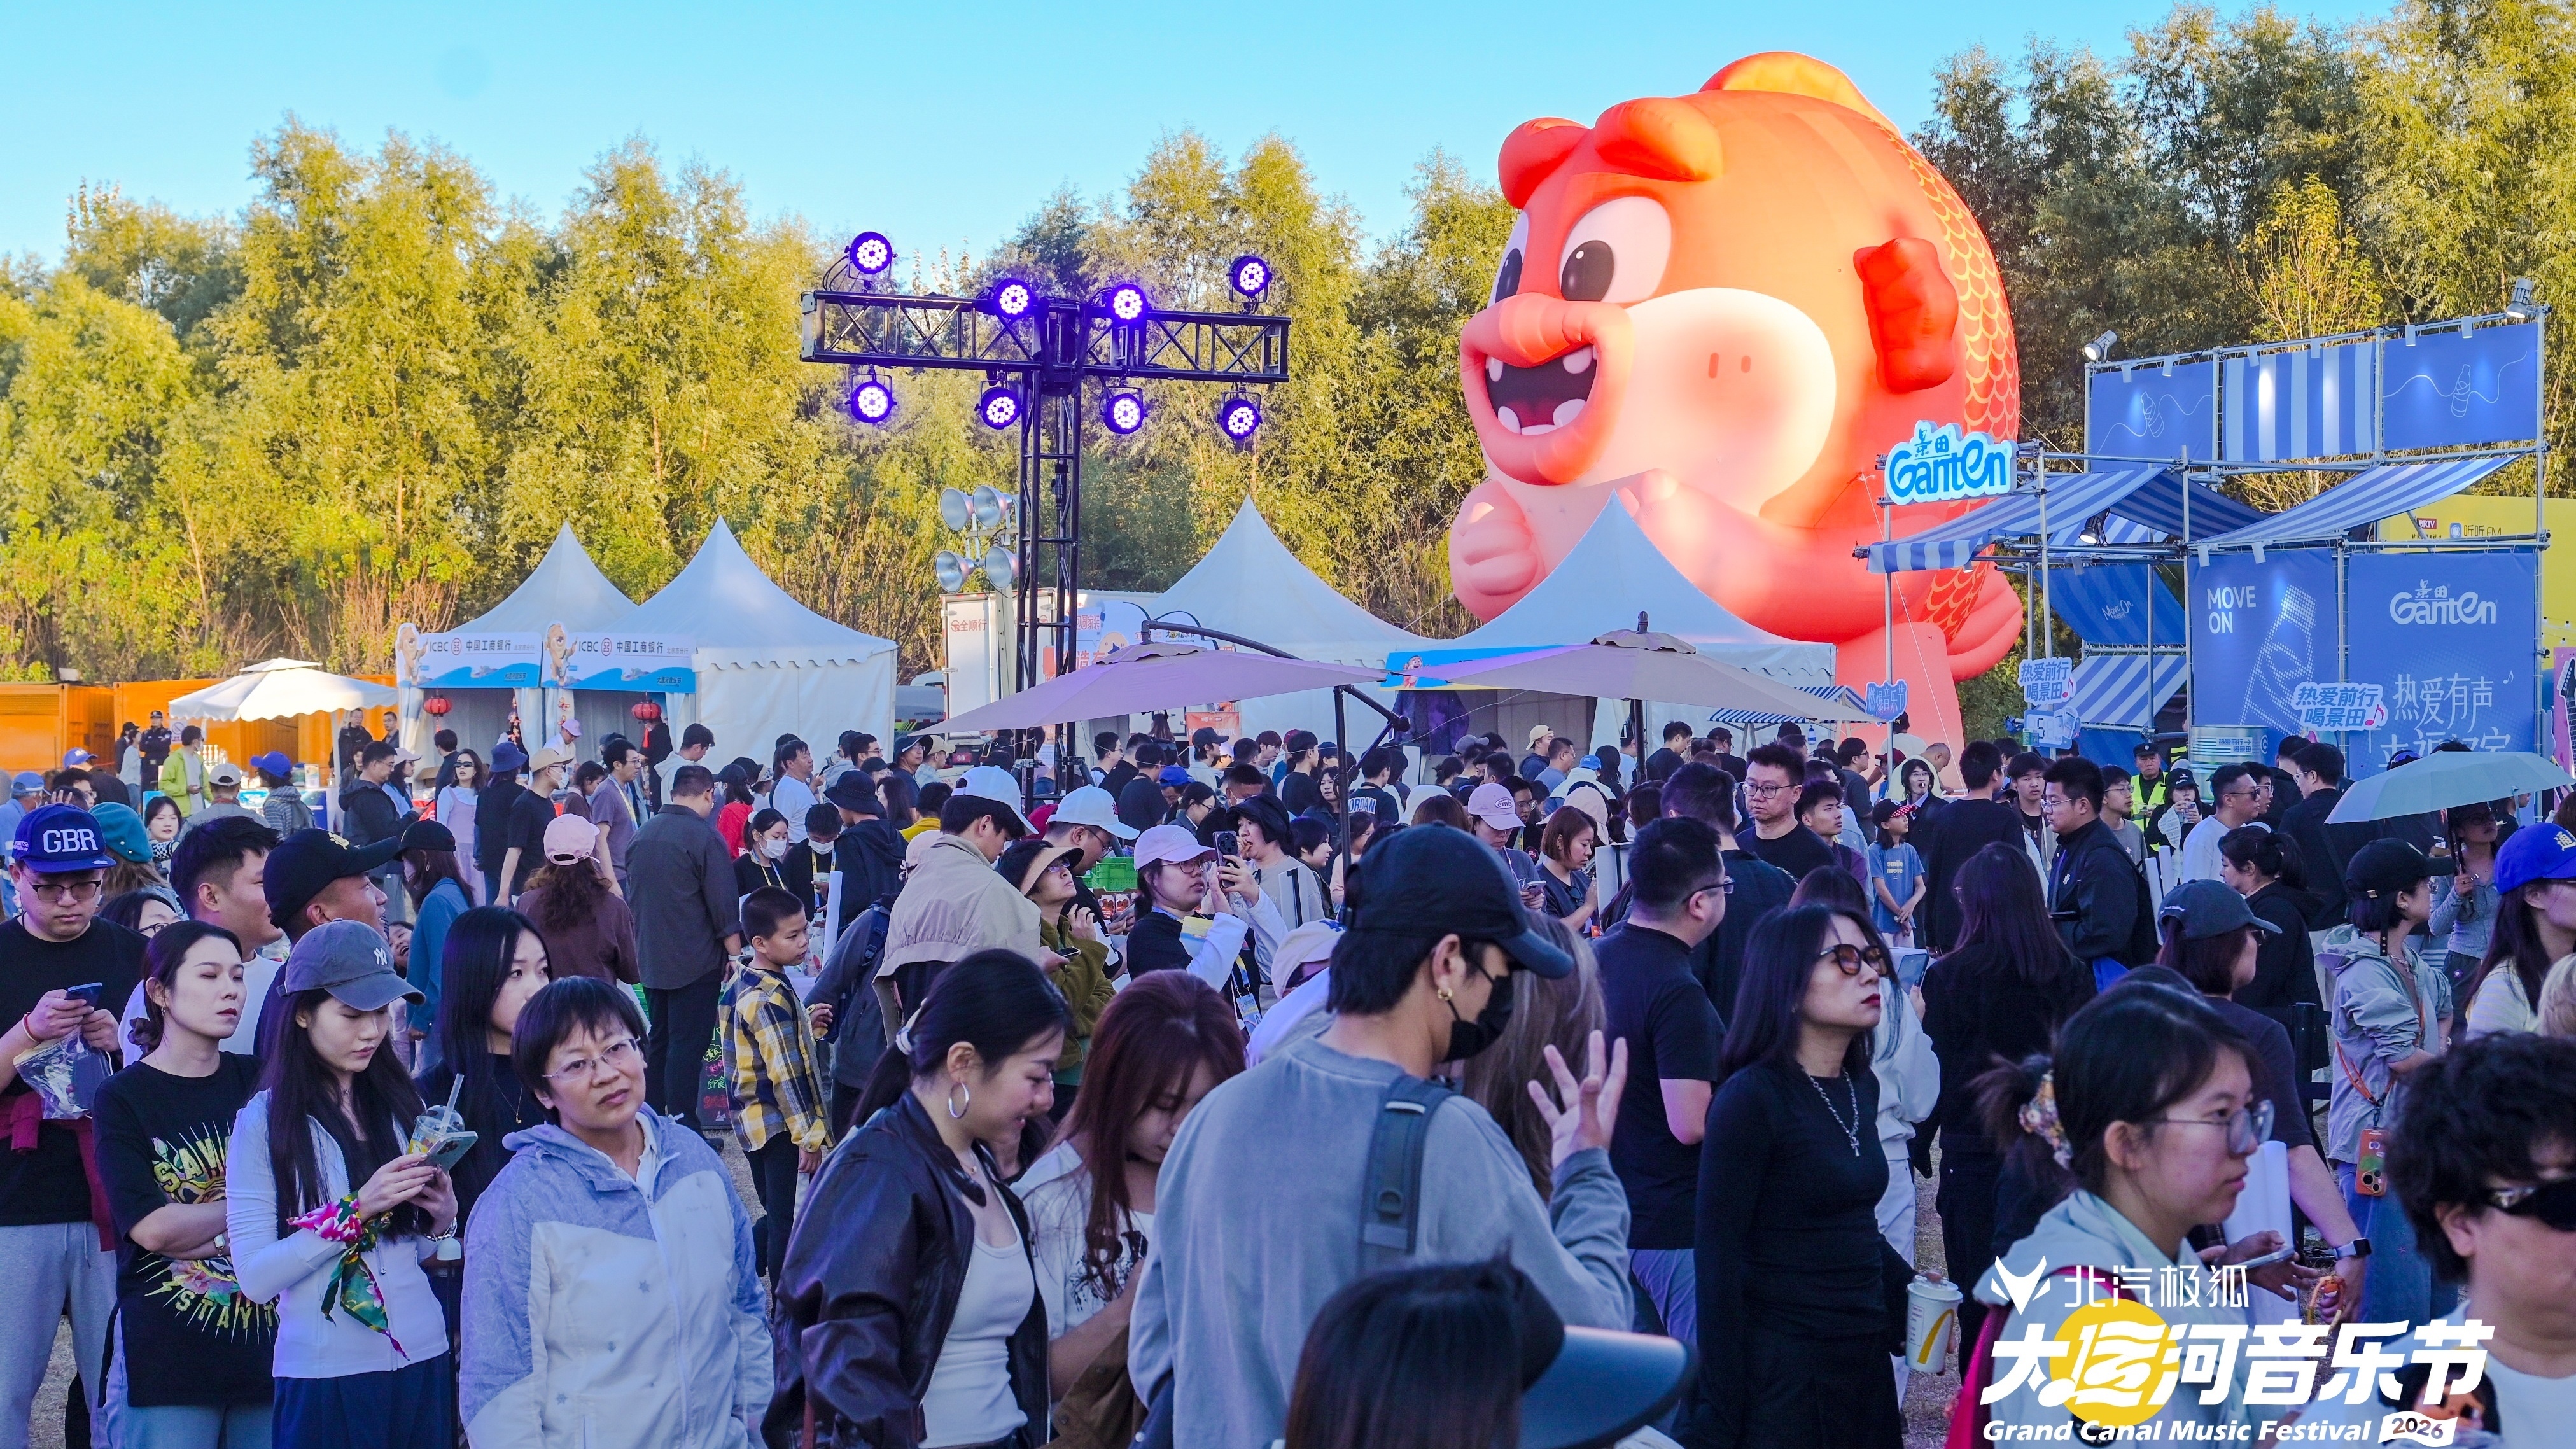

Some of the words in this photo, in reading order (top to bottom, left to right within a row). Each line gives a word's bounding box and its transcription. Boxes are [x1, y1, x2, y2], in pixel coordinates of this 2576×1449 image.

[1914, 428, 1949, 457] 景田
[1889, 440, 2006, 498] Ganten
[2207, 585, 2257, 610] MOVE
[2414, 579, 2448, 598] 景田
[2101, 605, 2121, 620] Move
[2390, 591, 2496, 625] Ganten
[2208, 611, 2233, 634] ON
[430, 641, 449, 652] ICBC
[466, 640, 511, 652] 中国工商银行
[578, 641, 599, 652] ICBC
[616, 640, 664, 654] 中国工商银行
[2020, 661, 2069, 683] 热爱前行
[2026, 682, 2063, 702] 喝景田
[2295, 686, 2379, 708] 热爱前行
[2392, 672, 2495, 734] 热爱有声
[2304, 707, 2367, 727] 喝景田
[1348, 797, 1377, 815] ORDAN
[43, 829, 98, 853] GBR
[374, 947, 388, 965] NY
